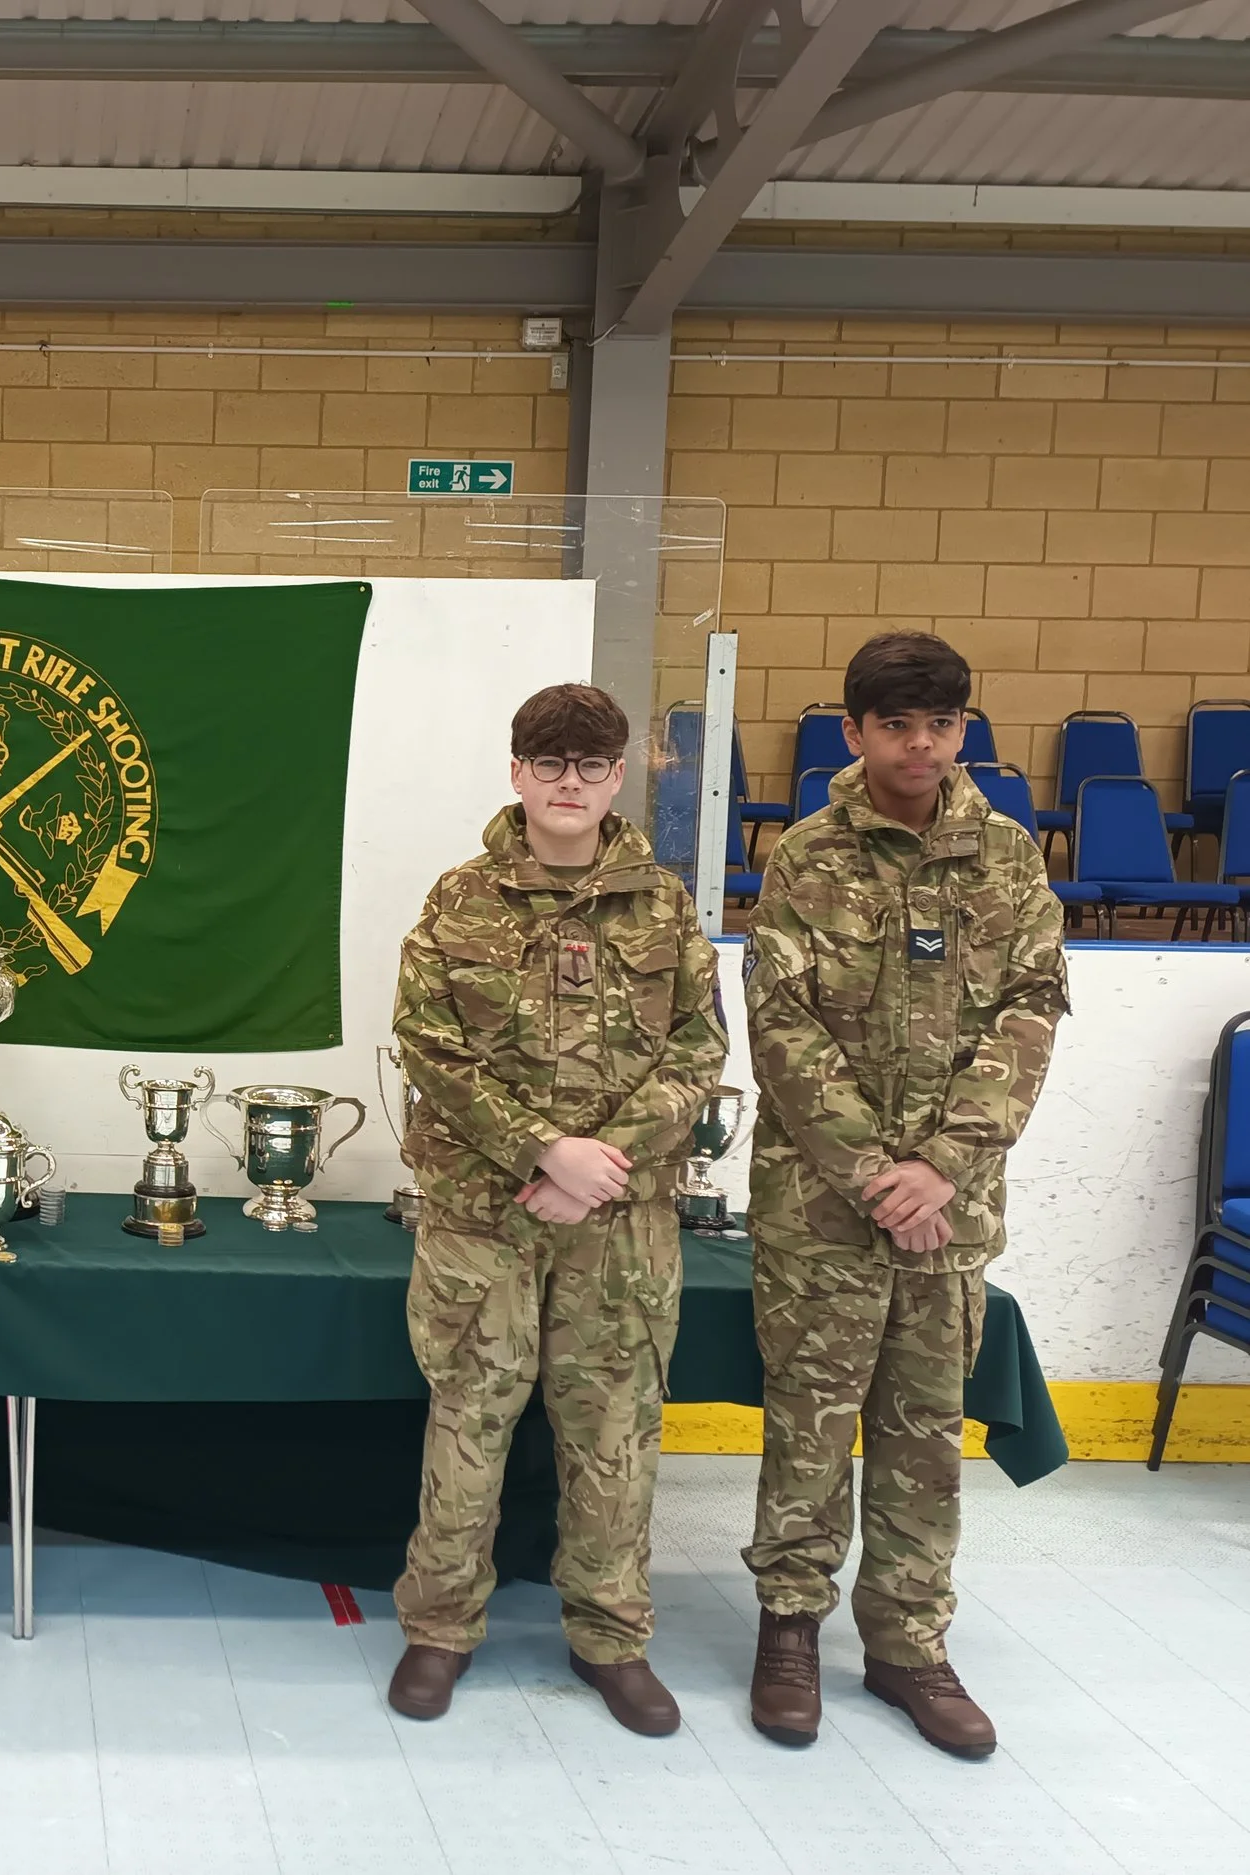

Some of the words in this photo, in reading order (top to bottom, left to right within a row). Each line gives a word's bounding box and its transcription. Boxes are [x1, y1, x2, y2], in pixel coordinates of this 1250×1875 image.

[419, 465, 441, 477] Fire
[419, 478, 440, 489] exit
[21, 645, 97, 704] RIFLE
[86, 696, 151, 864] SHOOTING
